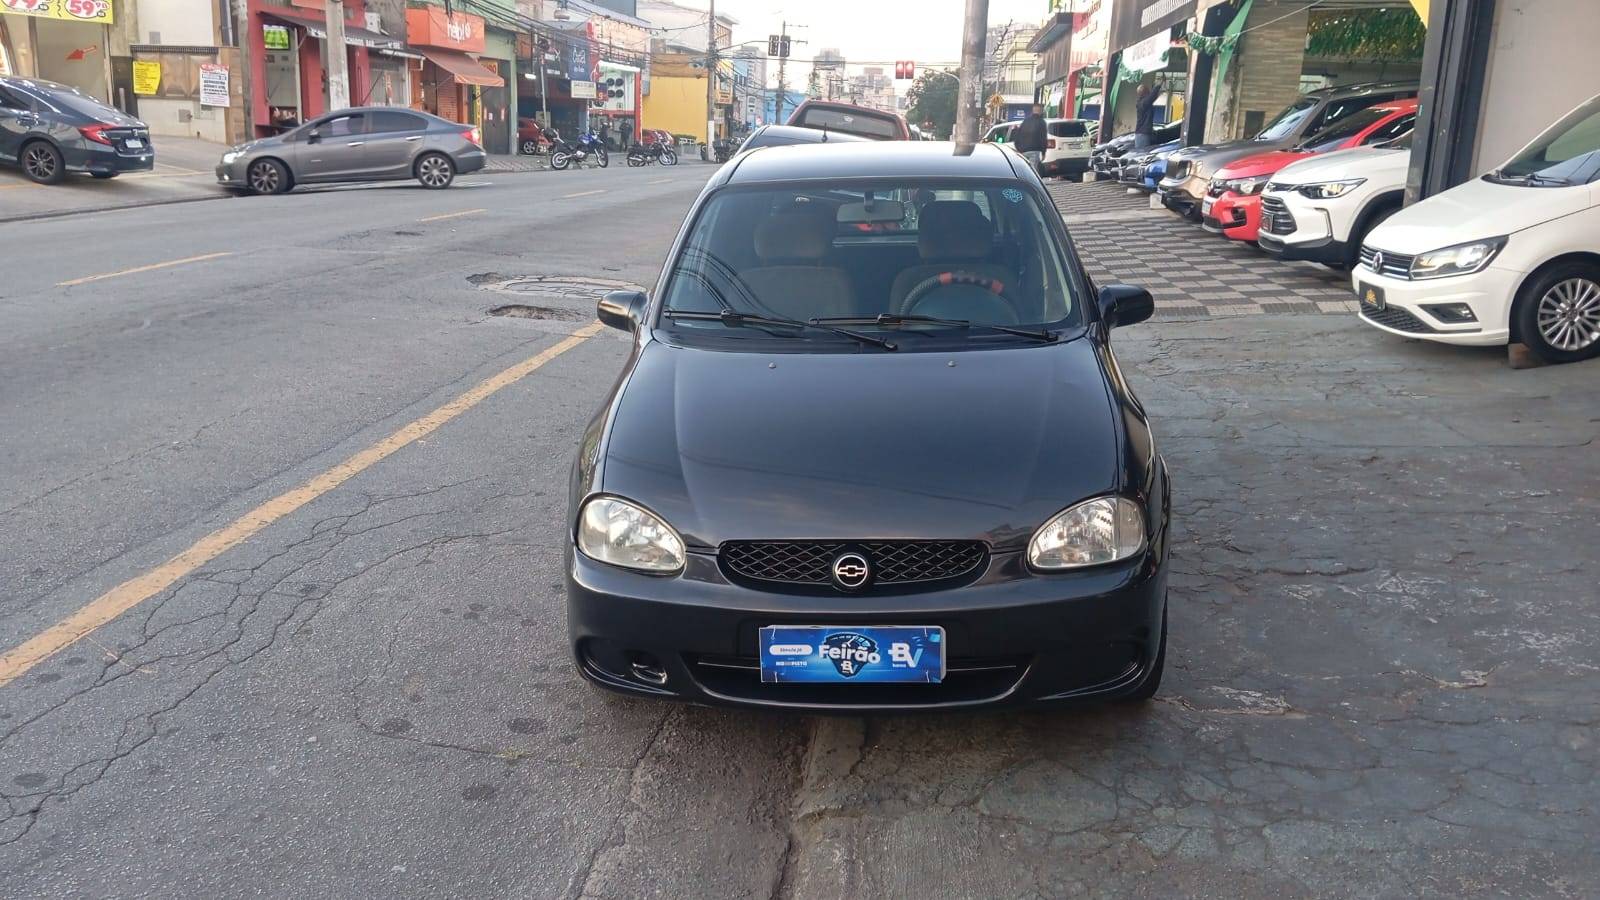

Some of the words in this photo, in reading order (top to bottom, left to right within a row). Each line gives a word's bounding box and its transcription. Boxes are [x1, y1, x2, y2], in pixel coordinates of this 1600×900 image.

[69, 0, 94, 16] 59
[818, 643, 881, 664] Feirão
[888, 643, 924, 668] BV
